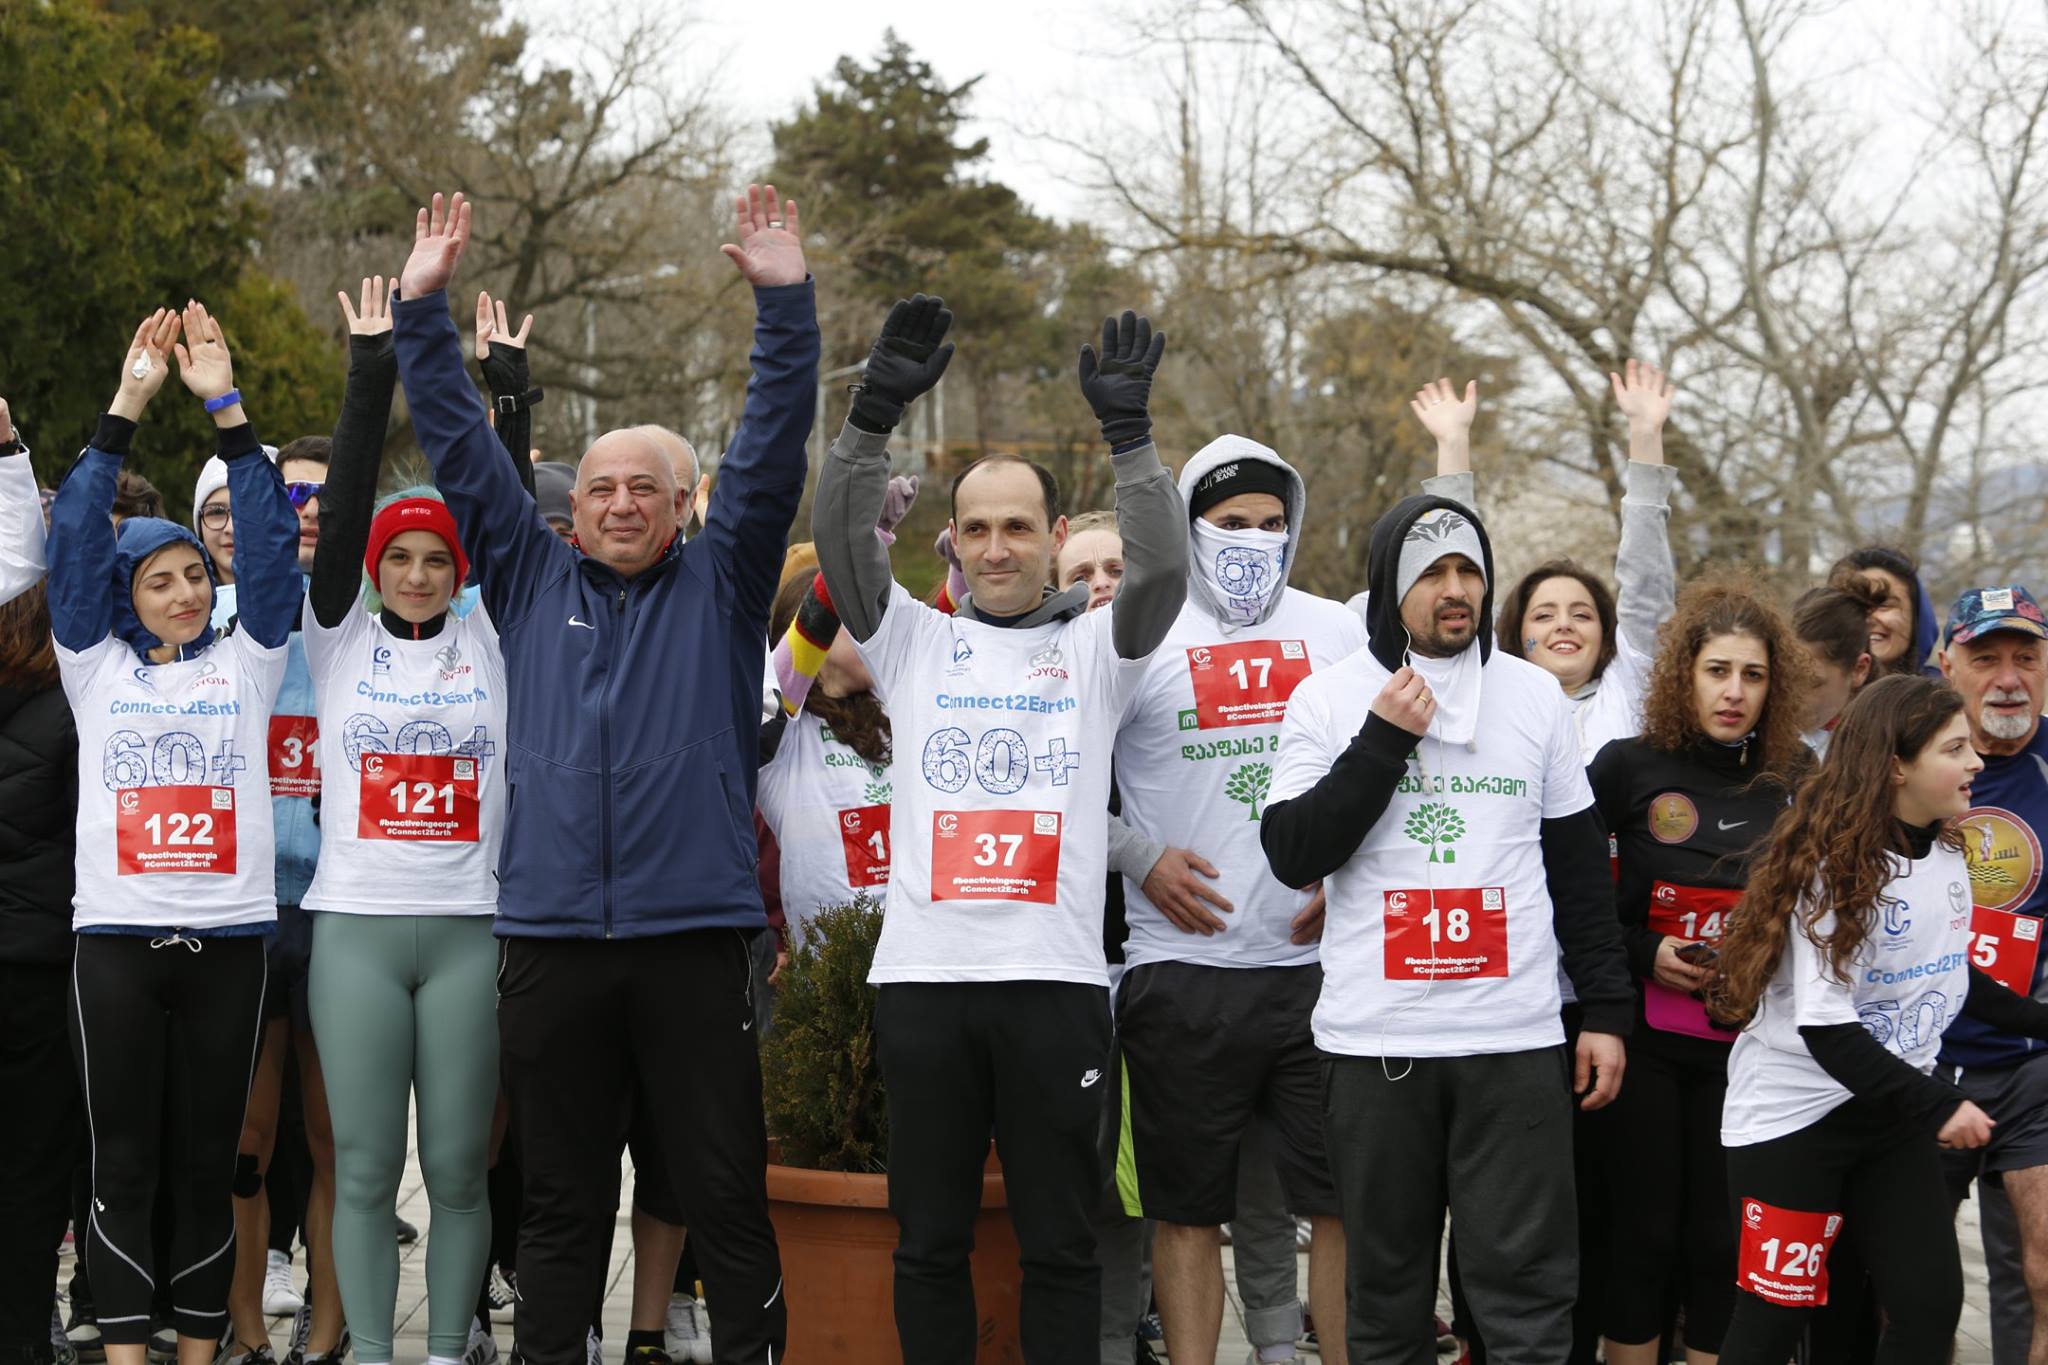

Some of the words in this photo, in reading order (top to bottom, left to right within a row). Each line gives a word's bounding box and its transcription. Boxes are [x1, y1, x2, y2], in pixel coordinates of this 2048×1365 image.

[1229, 658, 1273, 690] 17
[356, 680, 488, 706] Connect2Earth
[935, 694, 1077, 714] Connect2Earth
[103, 730, 247, 792] 60+
[922, 727, 1081, 796] 60+
[390, 781, 454, 814] 121
[144, 813, 214, 846] 122
[378, 818, 459, 829] #beactiveingeorgia
[387, 828, 452, 837] #Connect2Earth
[137, 850, 218, 861] #beactiveingeorgia
[144, 860, 211, 868] #Connect2Earth
[973, 833, 1024, 867] 37
[952, 876, 1037, 887] #beactiveingeorgia
[960, 885, 1029, 895] #Connect2Earth
[1422, 908, 1471, 943] 18
[1761, 1237, 1824, 1277] 126
